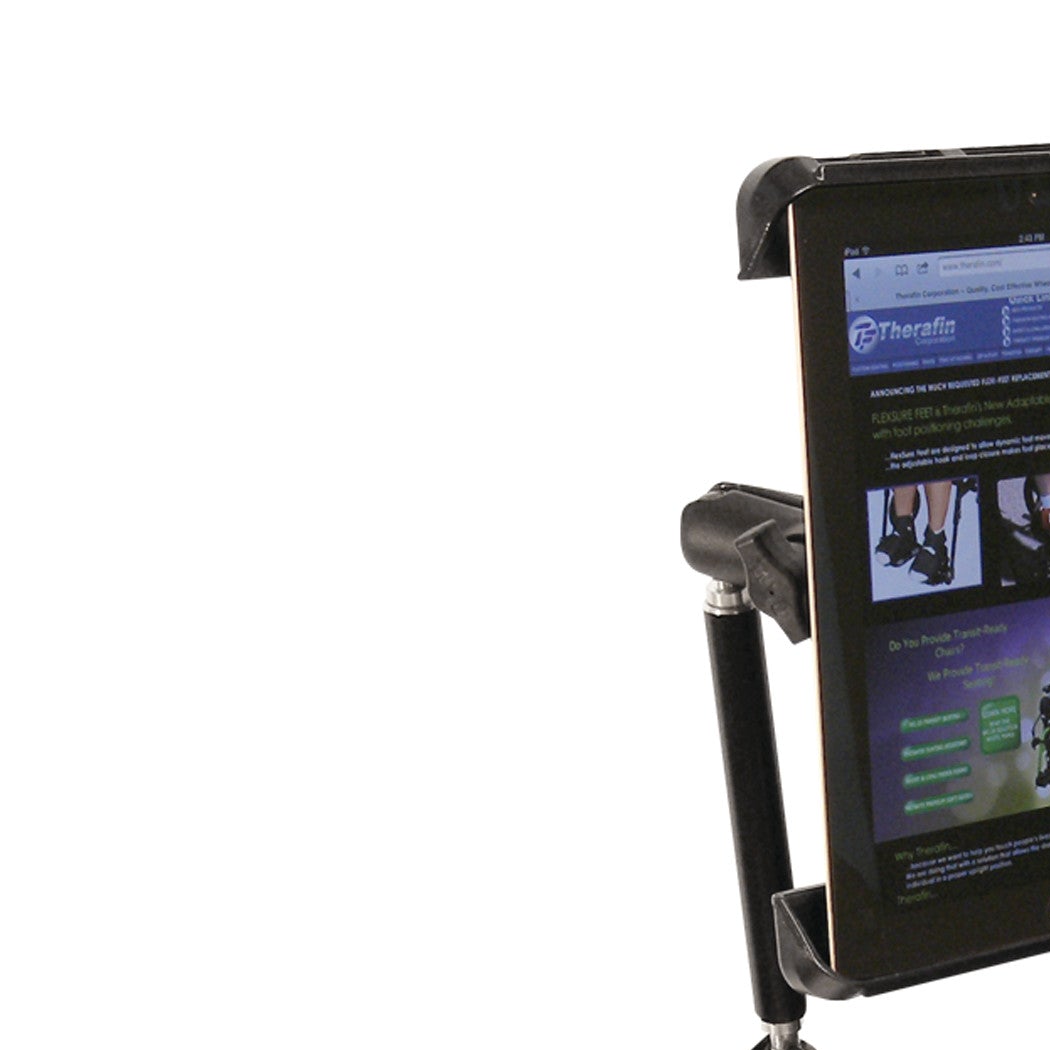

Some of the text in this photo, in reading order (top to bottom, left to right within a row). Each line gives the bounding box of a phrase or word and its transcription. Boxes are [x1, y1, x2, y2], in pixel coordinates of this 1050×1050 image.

[895, 291, 921, 299] Therafin
[922, 288, 959, 299] Corporation
[1006, 282, 1032, 290] Effective
[879, 316, 956, 341] Therafin
[914, 420, 962, 437] positioning
[889, 640, 902, 652] Do
[902, 637, 919, 648] You
